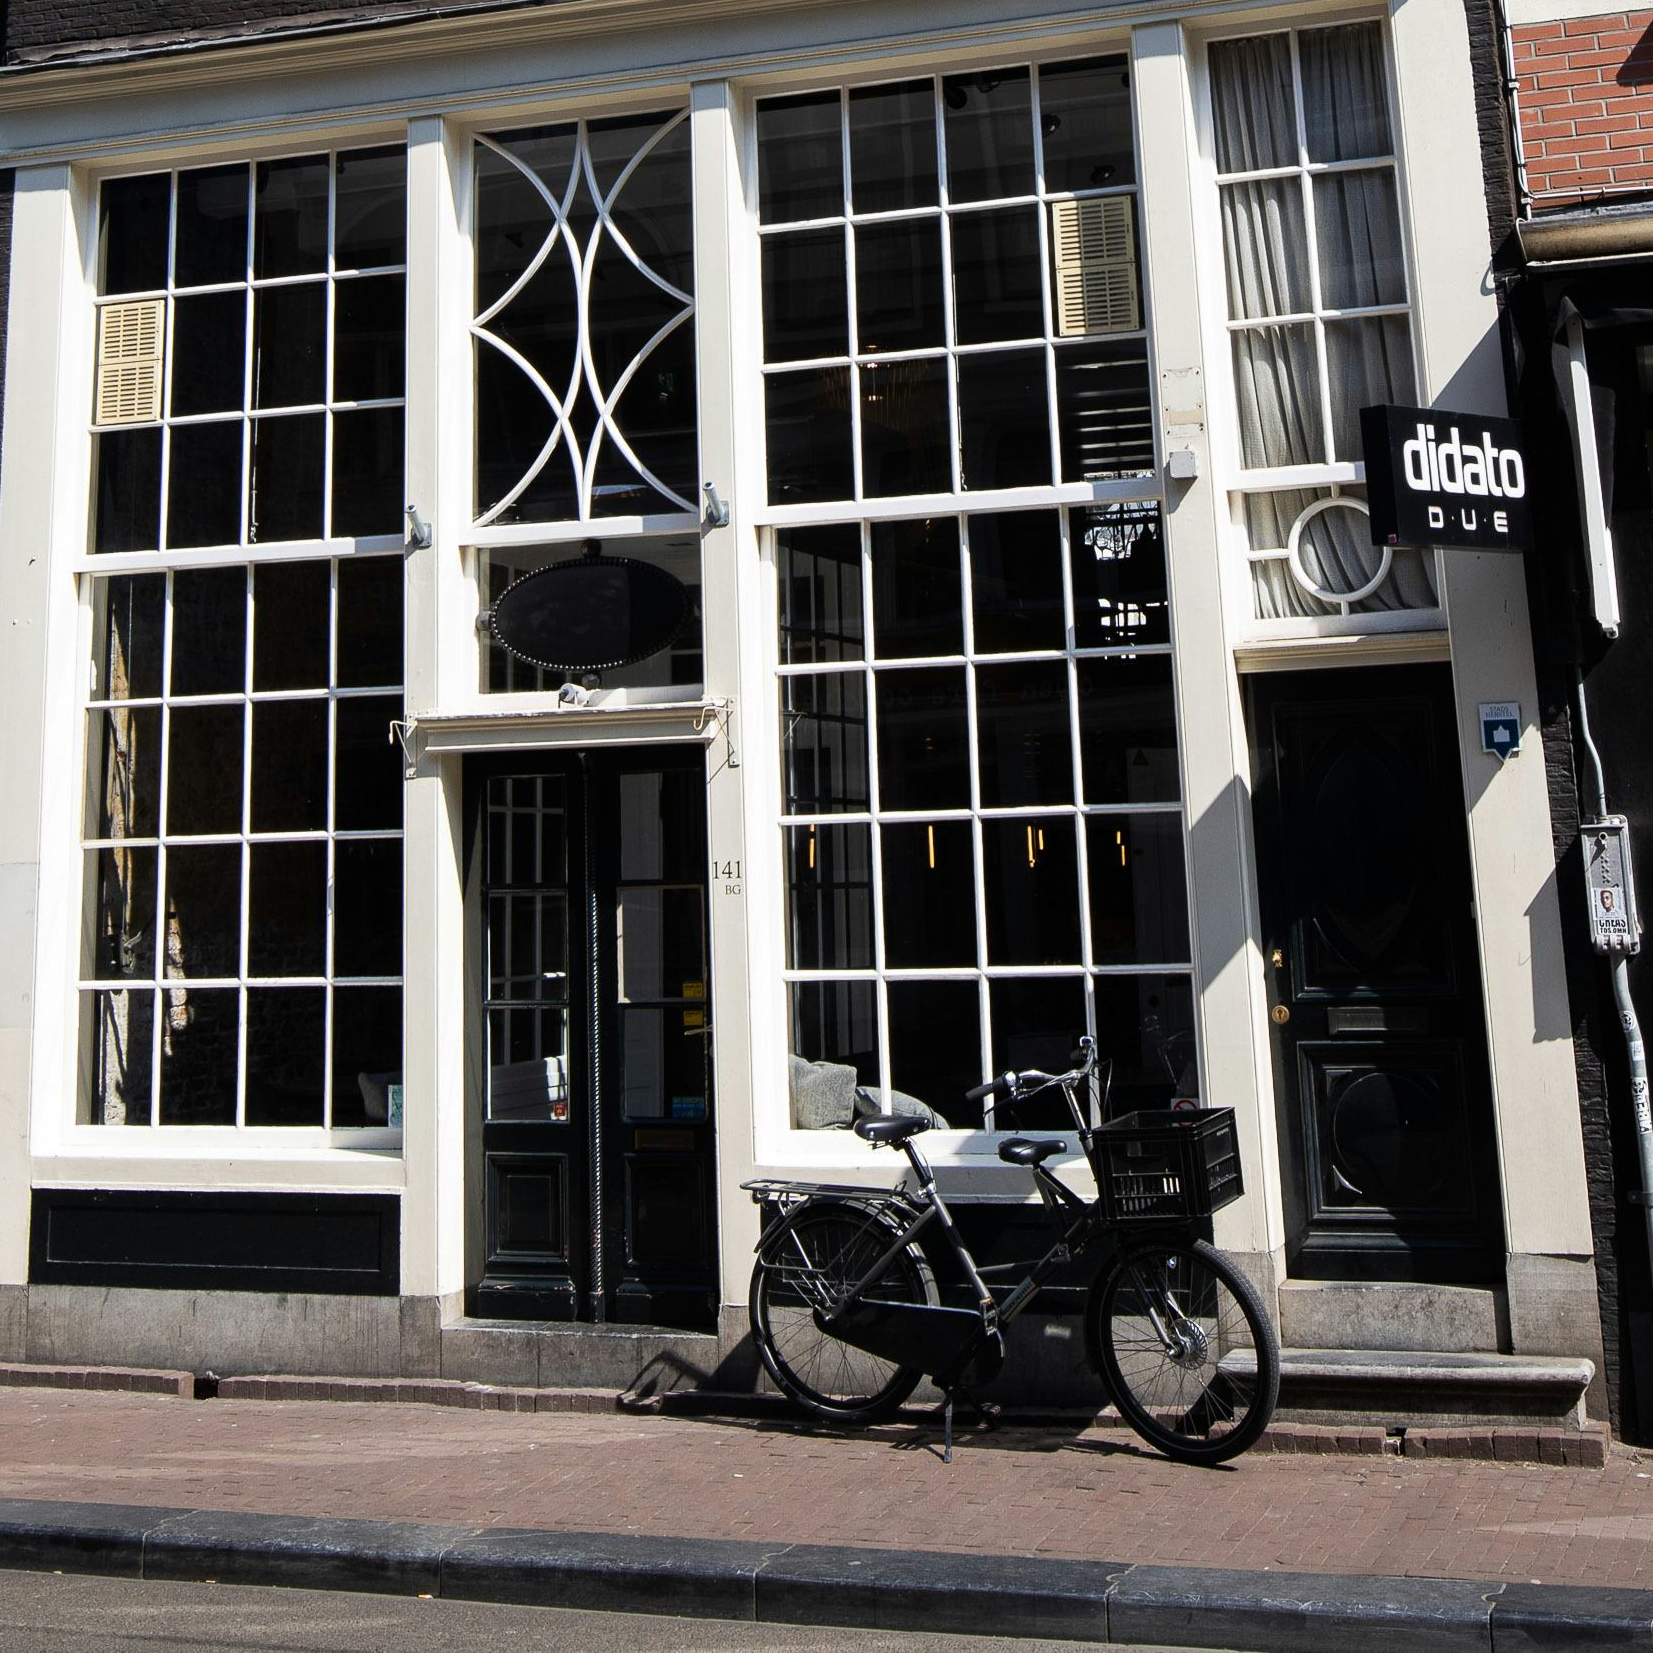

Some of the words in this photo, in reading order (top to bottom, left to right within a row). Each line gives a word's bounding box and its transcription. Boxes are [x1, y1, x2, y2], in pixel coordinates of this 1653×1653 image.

[1403, 423, 1525, 498] didato
[713, 860, 742, 880] 141
[725, 884, 742, 896] BG
